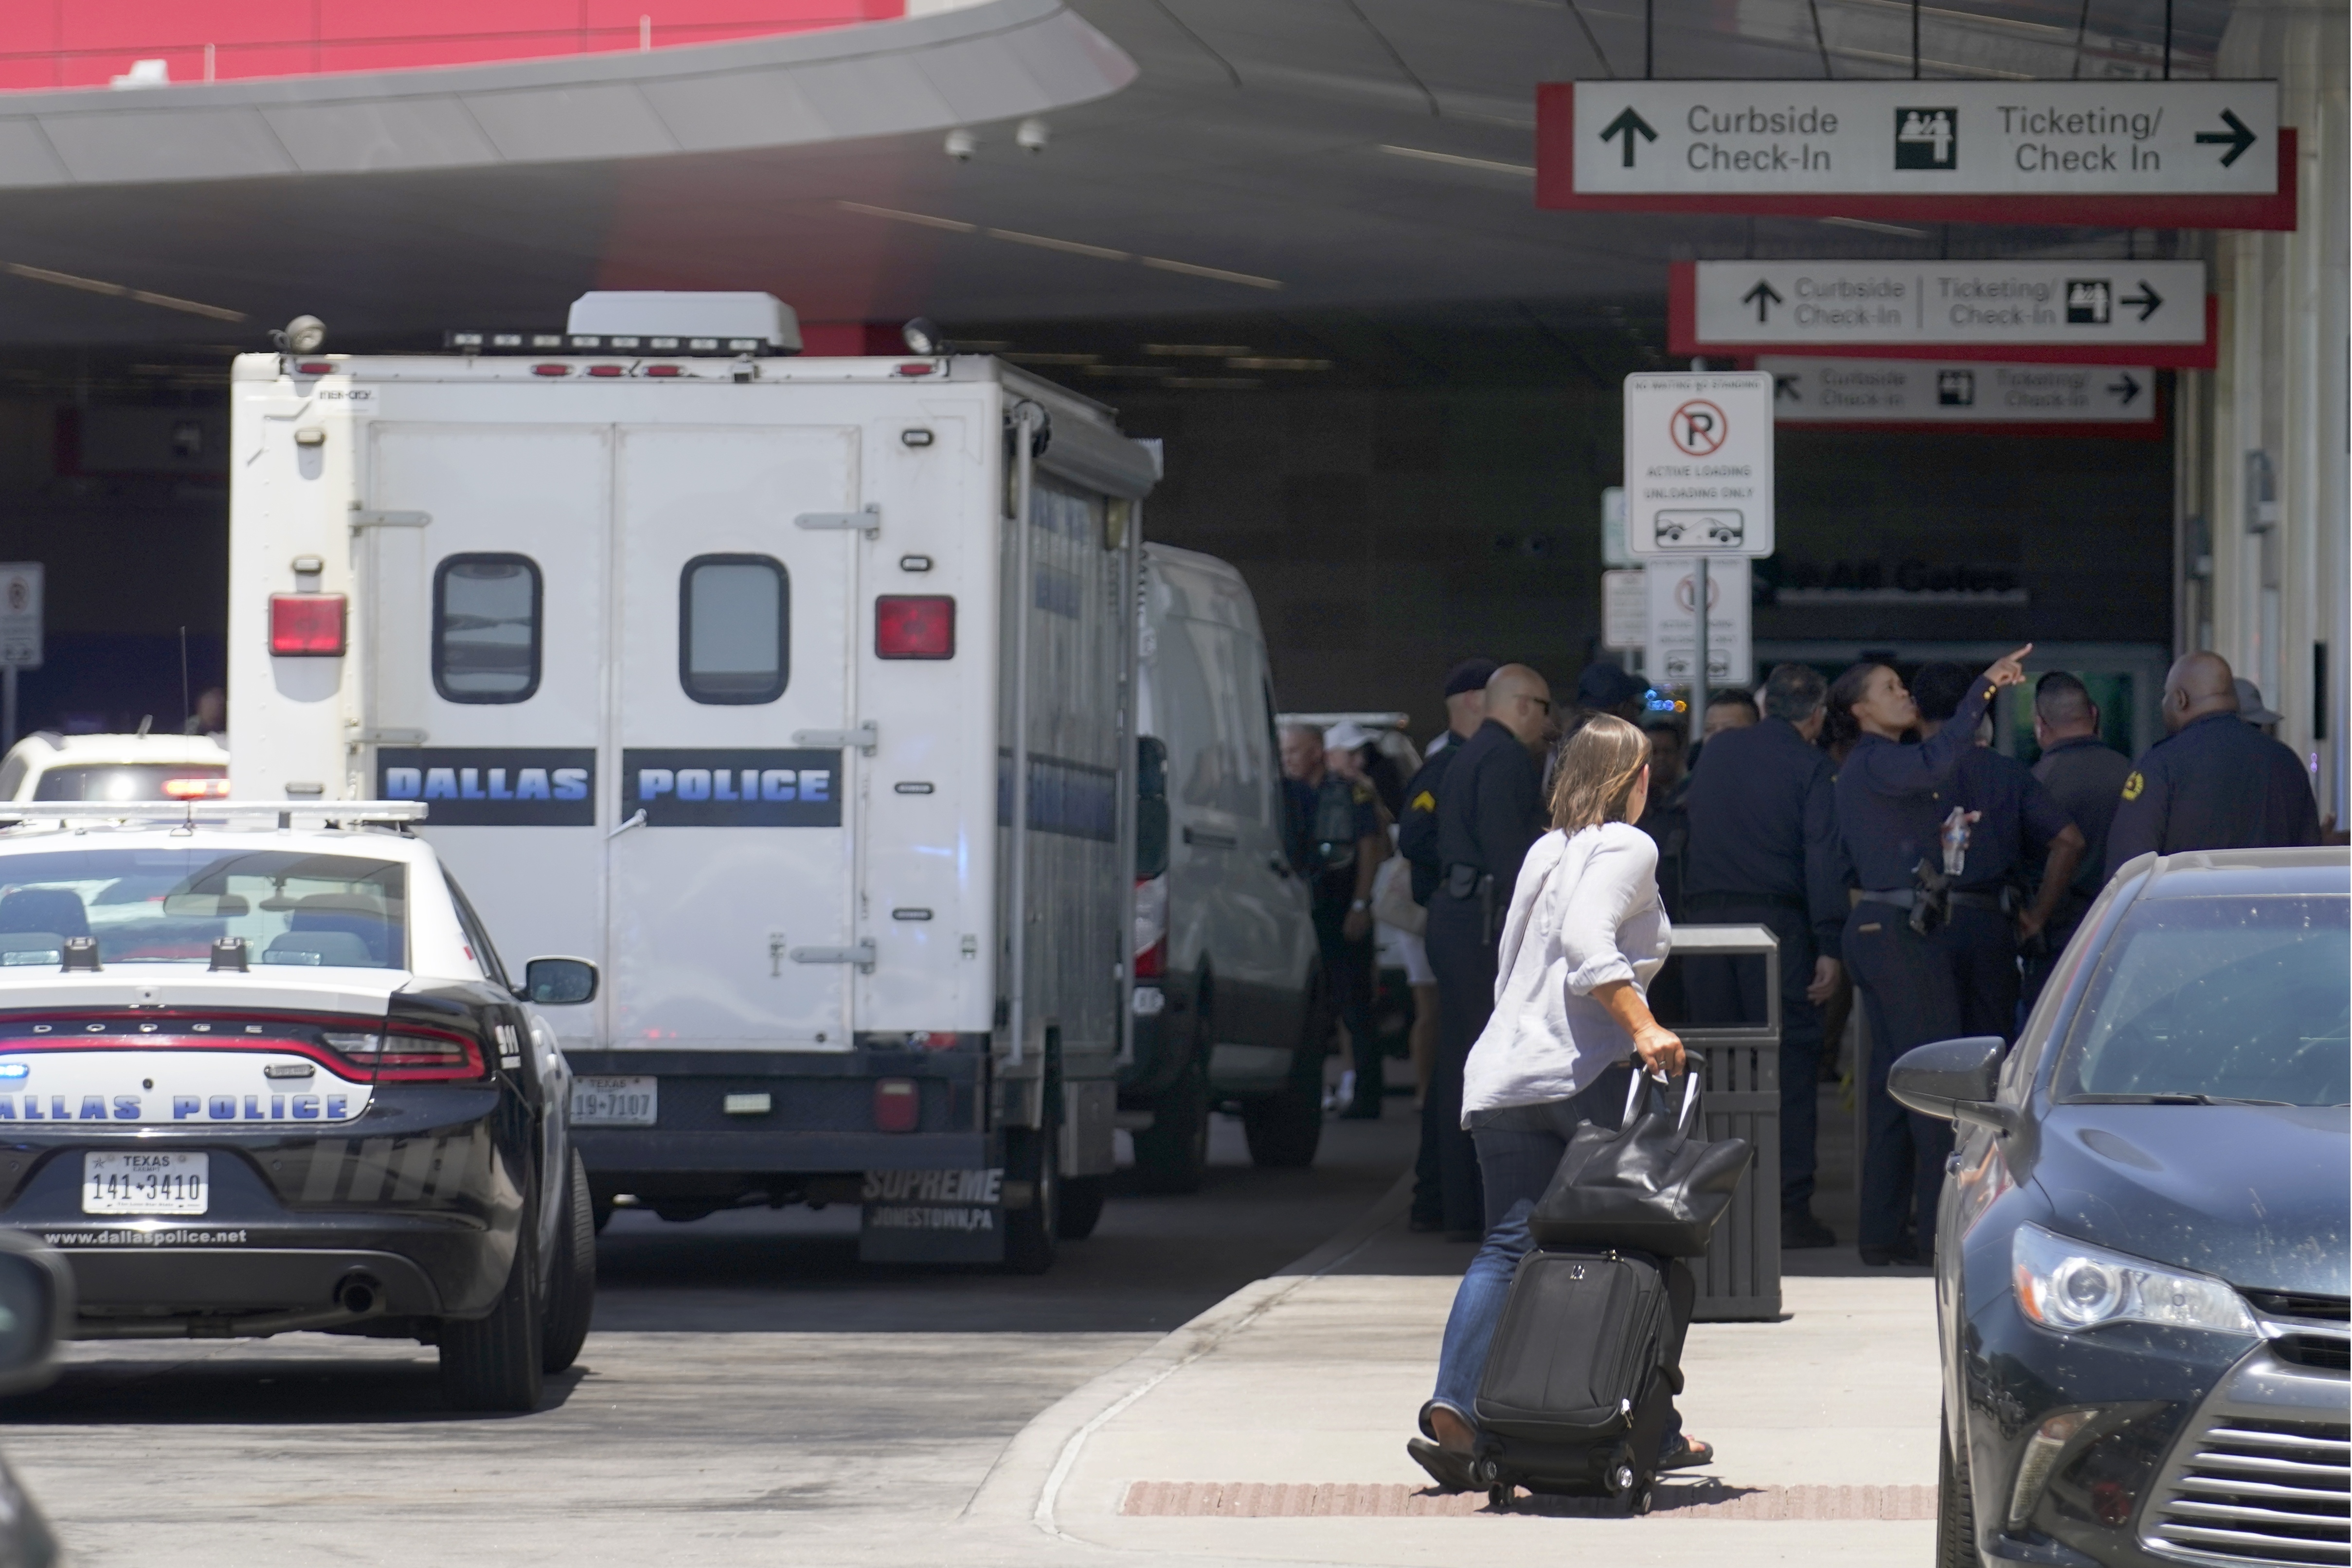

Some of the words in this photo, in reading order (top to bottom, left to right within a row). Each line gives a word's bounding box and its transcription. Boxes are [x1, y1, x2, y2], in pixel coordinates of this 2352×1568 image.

[1687, 105, 1838, 134] Curbside
[1997, 106, 2164, 140] Ticketing/
[1687, 143, 1831, 171] Check-In
[2016, 143, 2117, 171] Check
[2132, 143, 2160, 171] In
[1795, 277, 1905, 300] Curbside
[1938, 277, 2059, 302] Ticketing/
[1795, 303, 1902, 325] Check-In
[1949, 303, 2056, 325] Check-In
[1646, 465, 1690, 476] ACTIVE
[1695, 465, 1752, 476] LOADING
[1644, 487, 1718, 499] UNLOADING
[1720, 487, 1755, 499] ONLY
[386, 767, 588, 800] DALLAS
[638, 768, 830, 802] POLICE
[33, 1023, 263, 1034] DODGE
[0, 1094, 141, 1119] ALLAS
[173, 1094, 348, 1119] POLICE
[570, 1094, 597, 1115] 19
[124, 1156, 170, 1167] TEXAS
[861, 1168, 1005, 1202] SUPREME
[44, 1229, 247, 1246] www.dallaspolice.net
